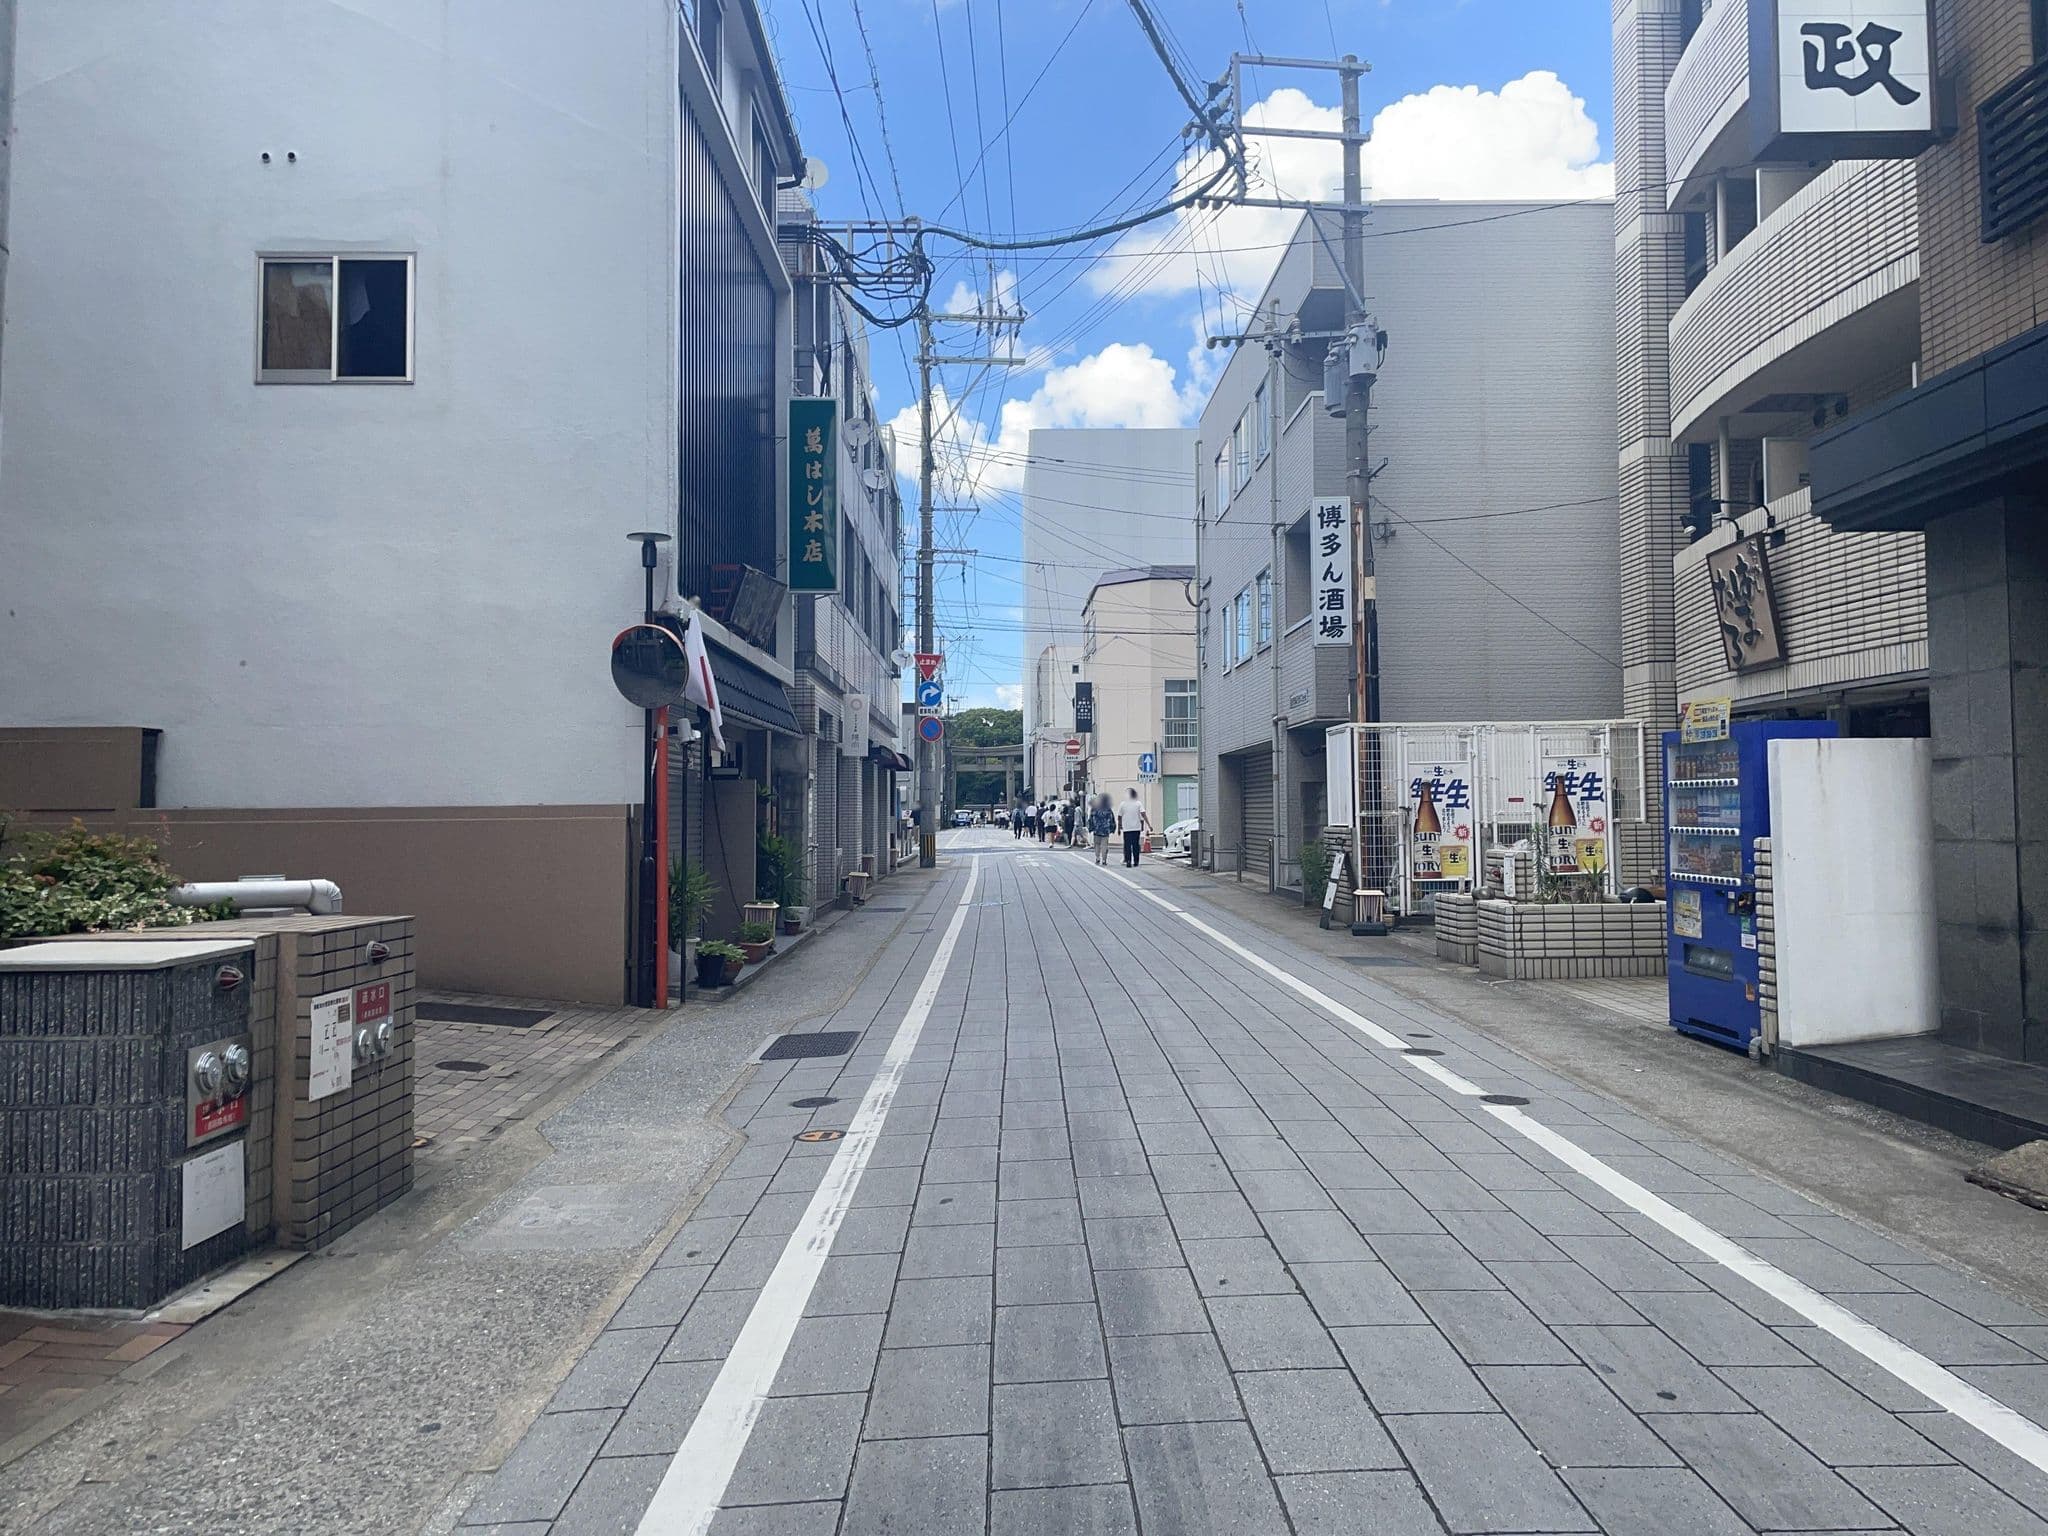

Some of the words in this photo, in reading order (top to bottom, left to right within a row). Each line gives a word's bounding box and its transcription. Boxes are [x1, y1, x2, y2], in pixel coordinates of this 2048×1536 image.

[1800, 21, 1921, 106] 政
[1317, 504, 1347, 639] 博多ん酒場
